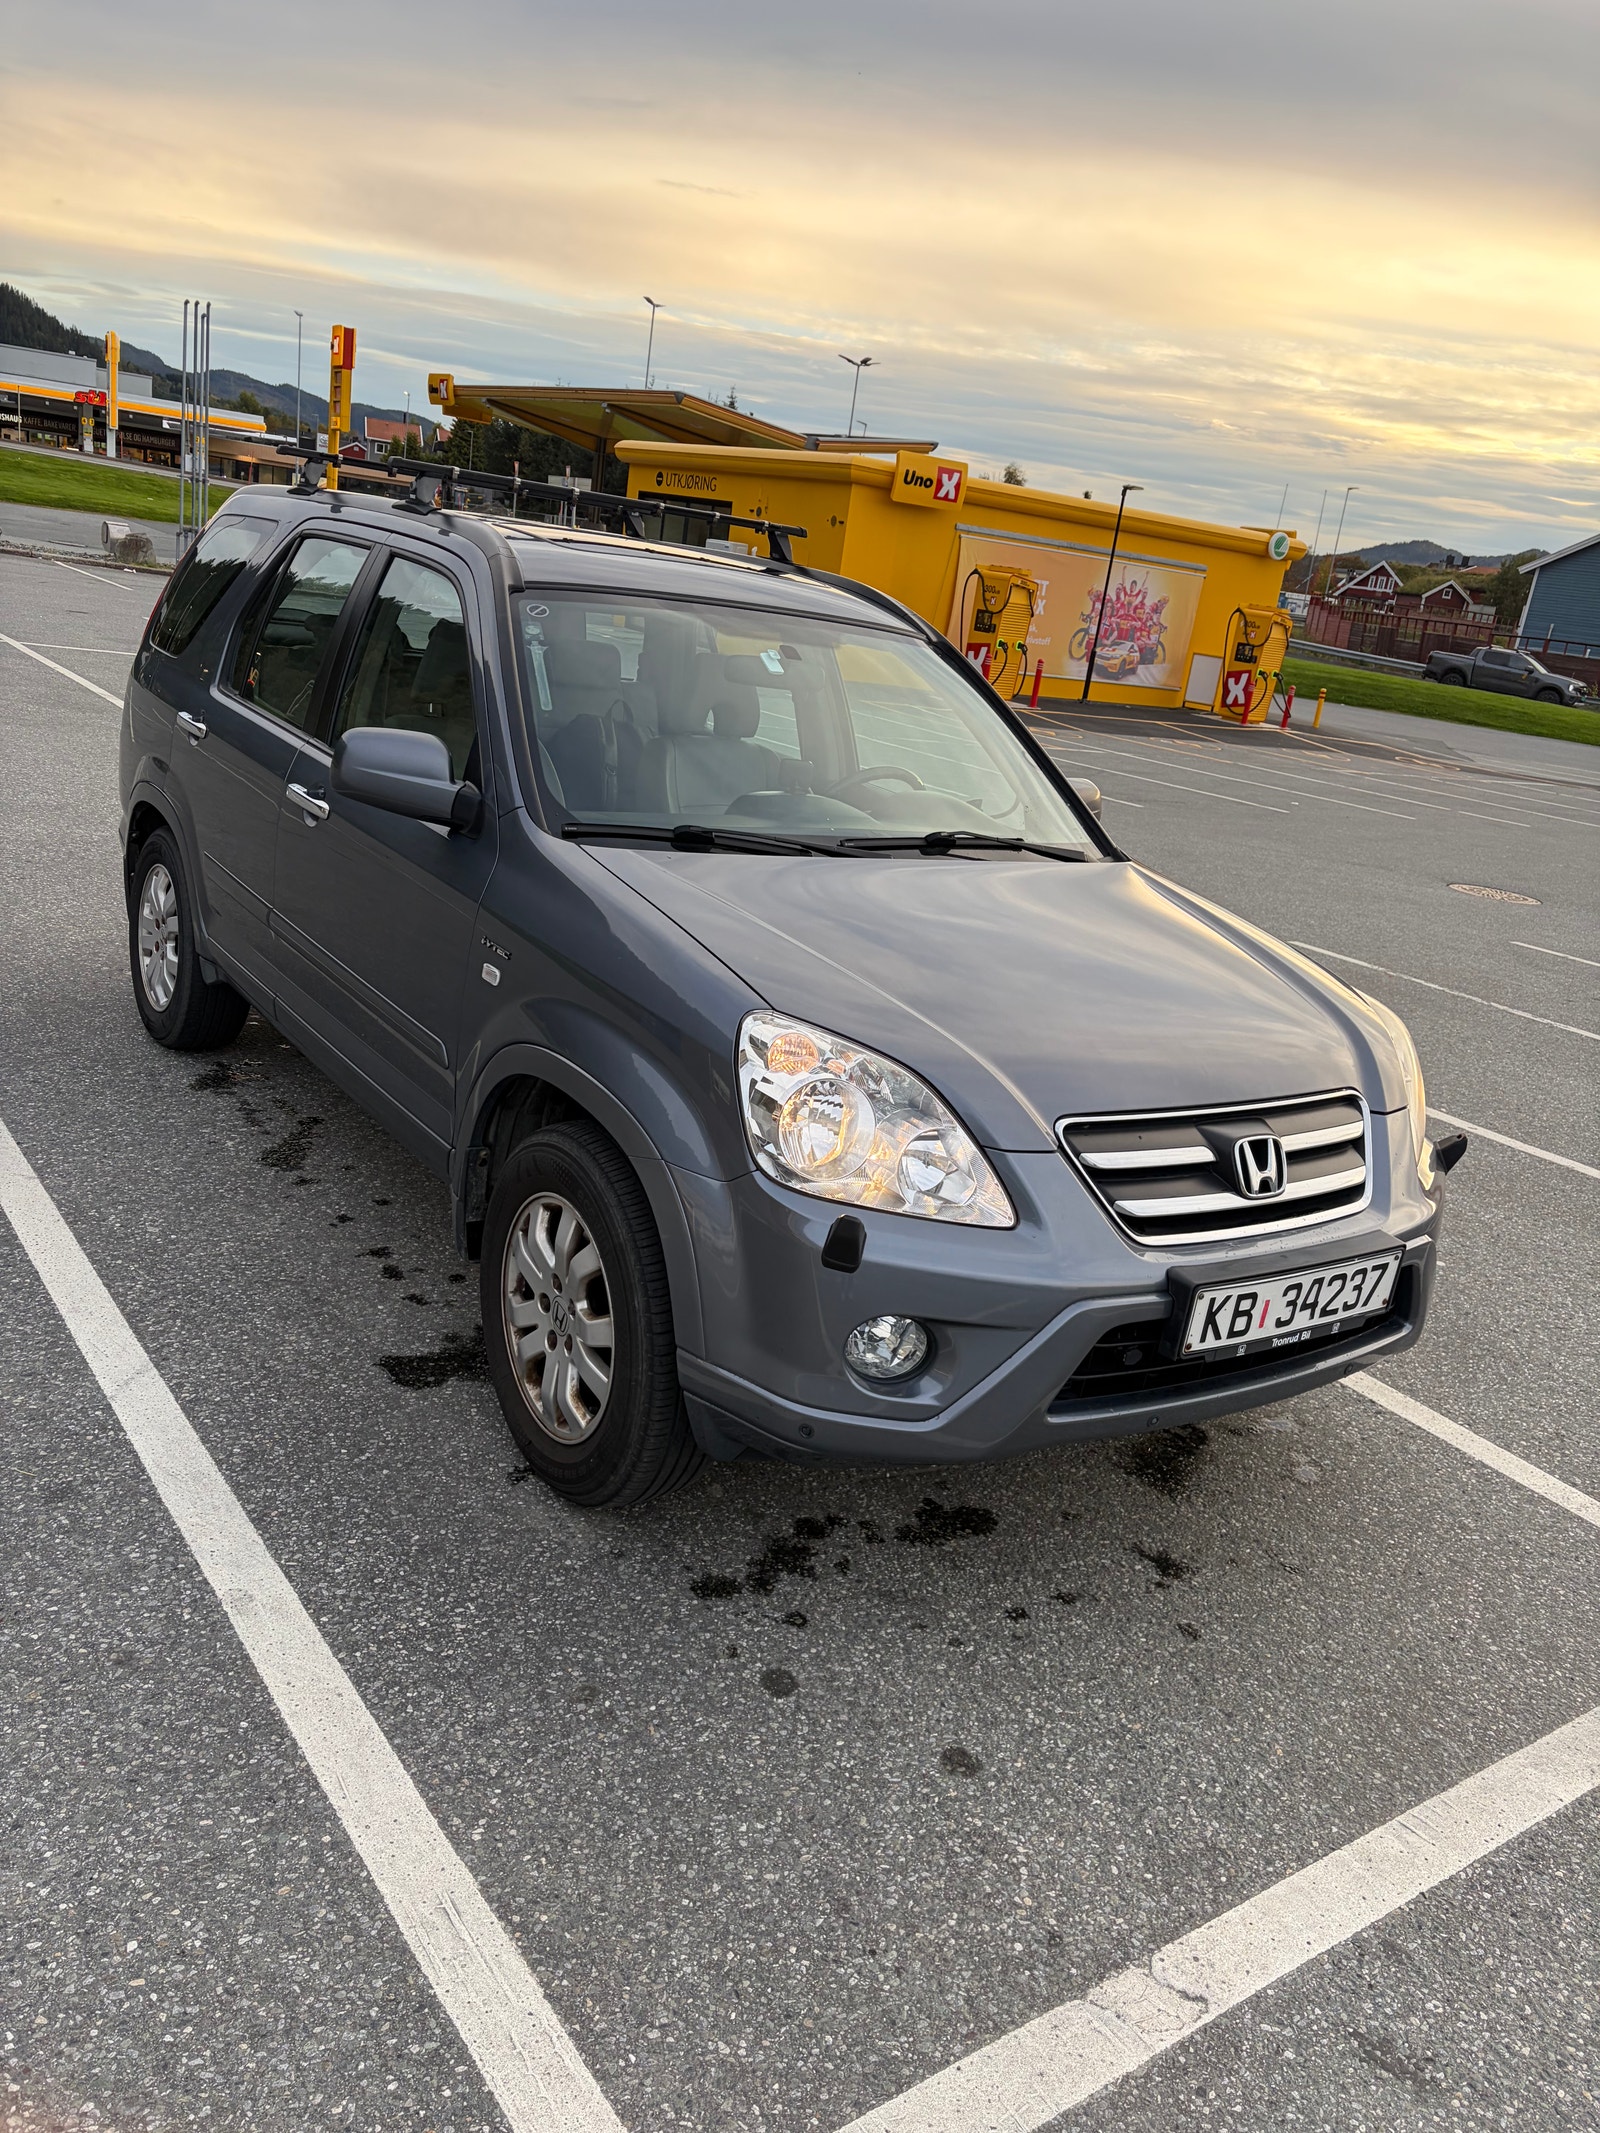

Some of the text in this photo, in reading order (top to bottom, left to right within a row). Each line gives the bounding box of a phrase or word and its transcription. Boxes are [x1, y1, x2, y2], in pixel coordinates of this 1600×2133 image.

[665, 471, 718, 492] UTKJØRING
[903, 468, 961, 500] Uno X
[1226, 672, 1250, 705] X
[1200, 1262, 1390, 1344] KB 34237
[1272, 1330, 1311, 1347] Tronrud Bil
